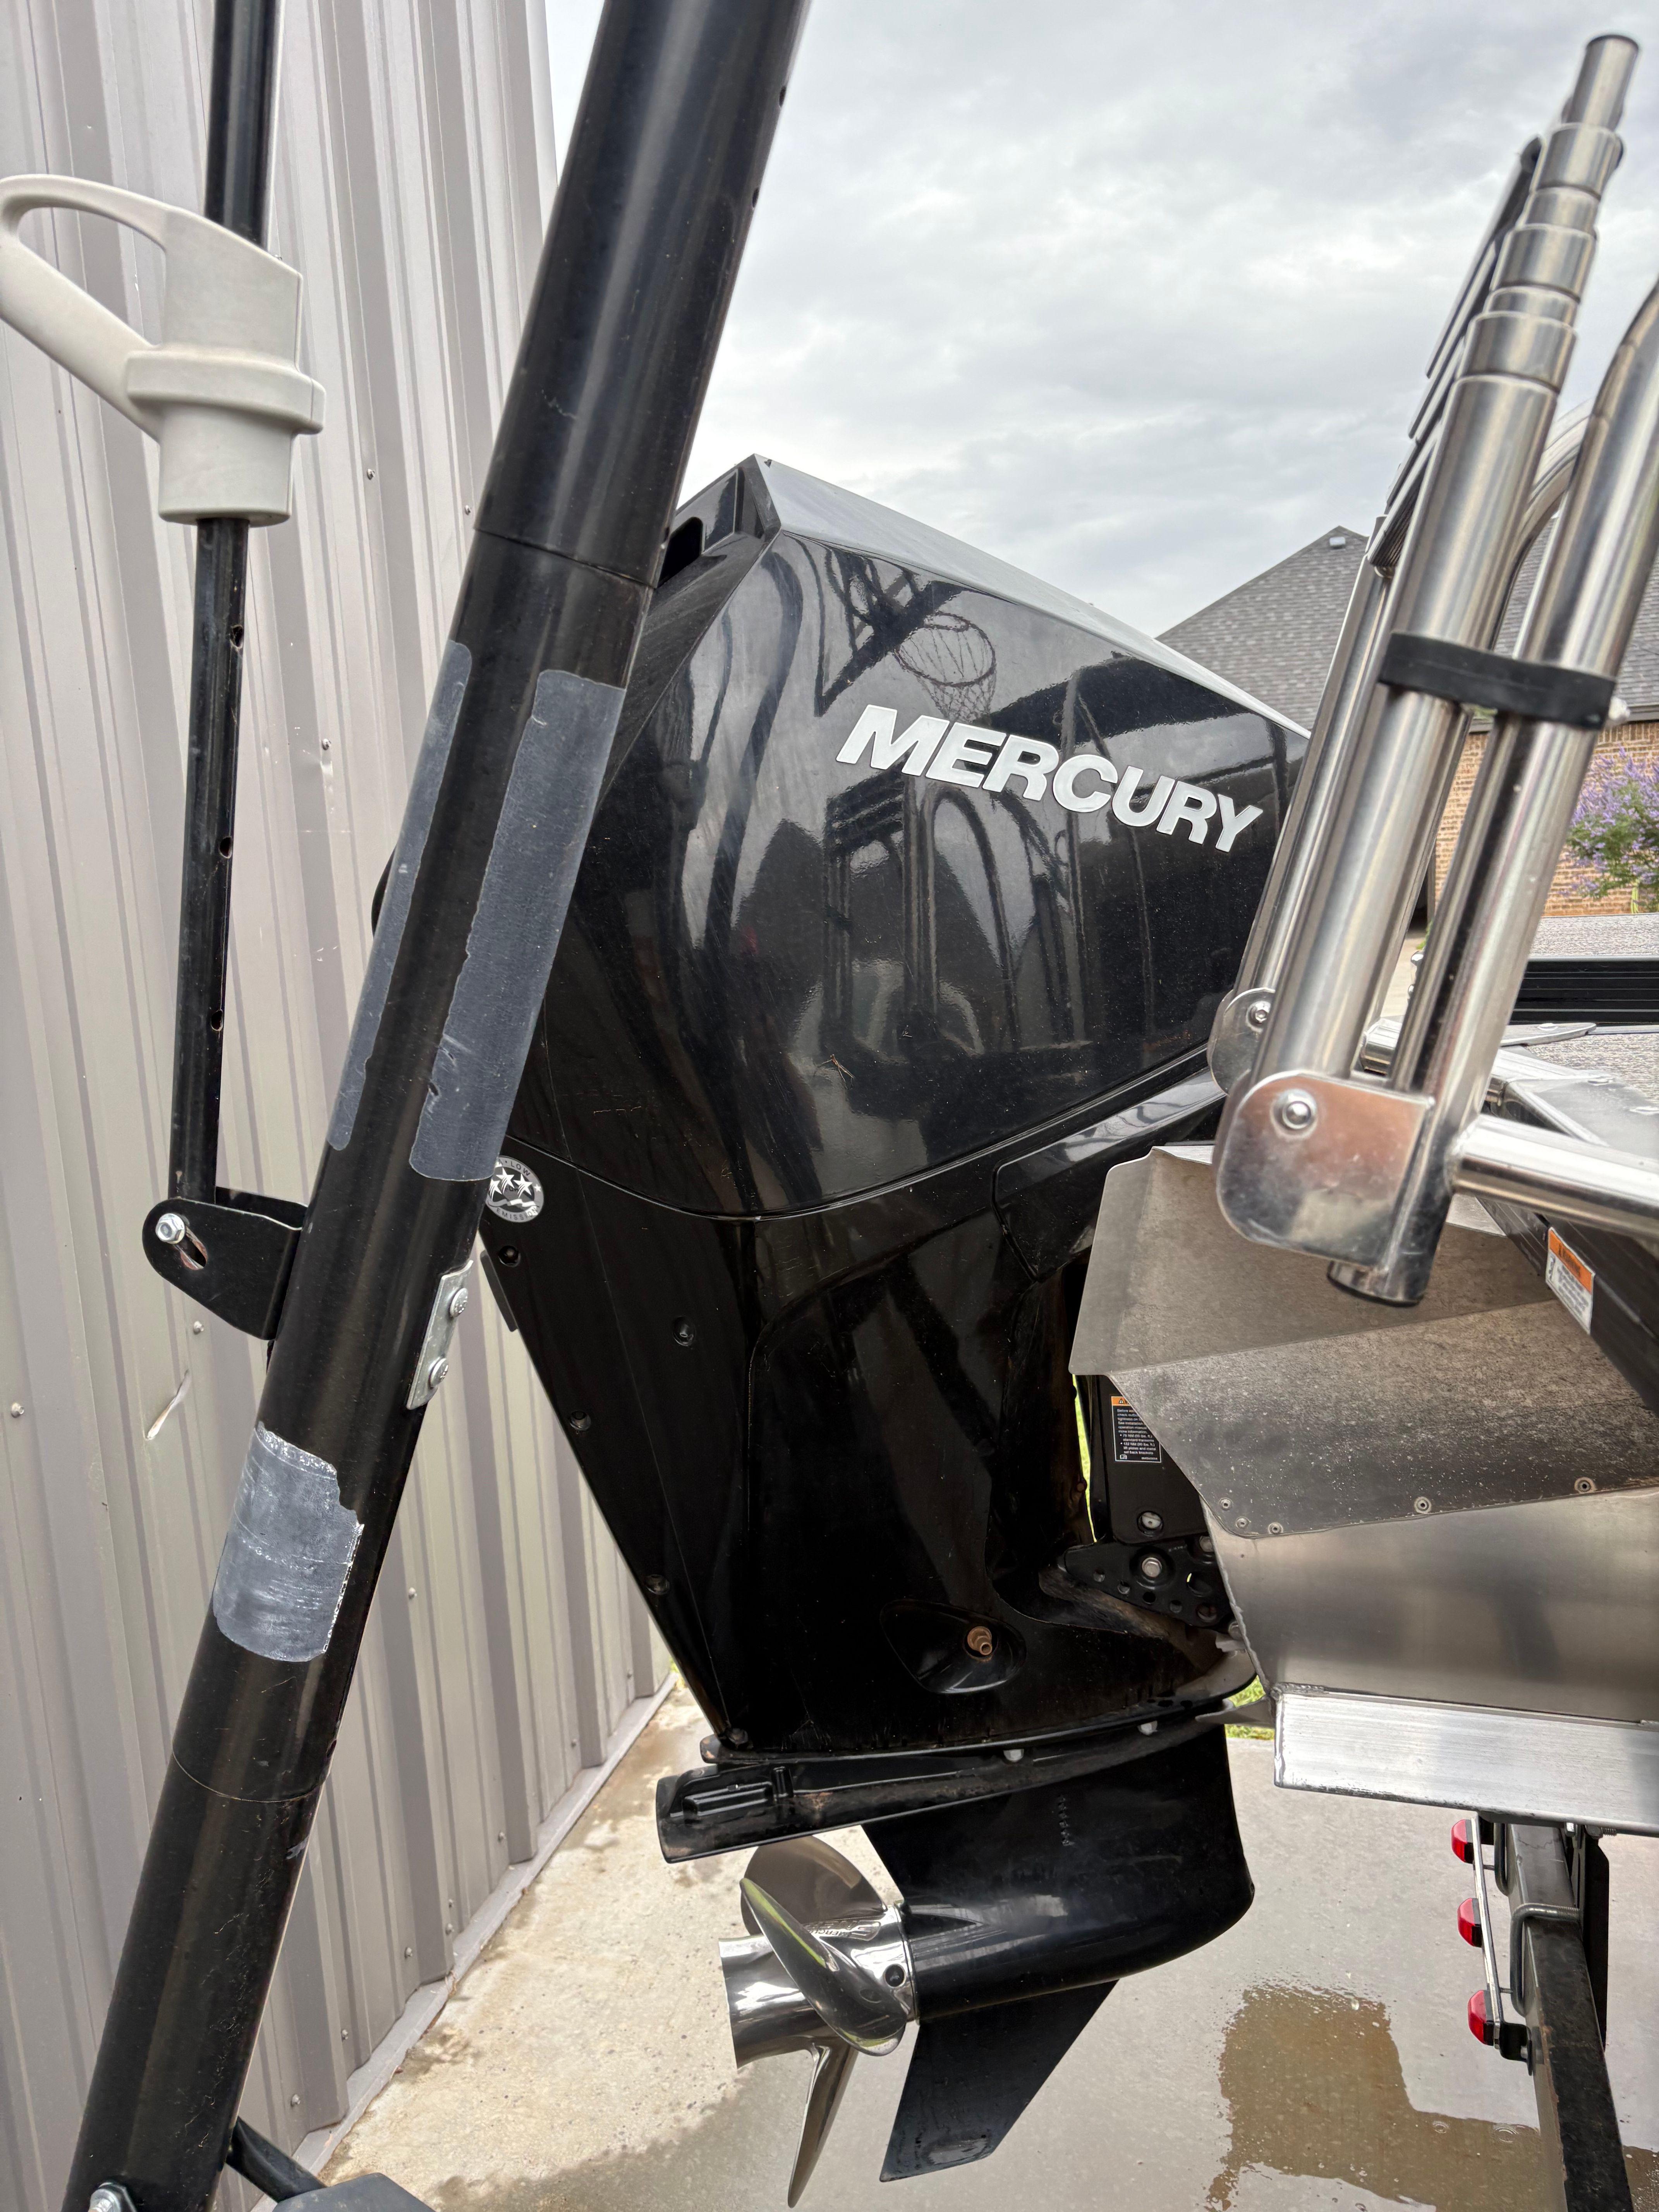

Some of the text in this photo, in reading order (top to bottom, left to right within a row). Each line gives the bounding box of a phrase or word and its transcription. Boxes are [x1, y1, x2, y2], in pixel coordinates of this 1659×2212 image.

[836, 704, 1263, 852] MERCURY
[510, 1161, 531, 1176] LOW
[496, 1206, 539, 1221] EMISSION
